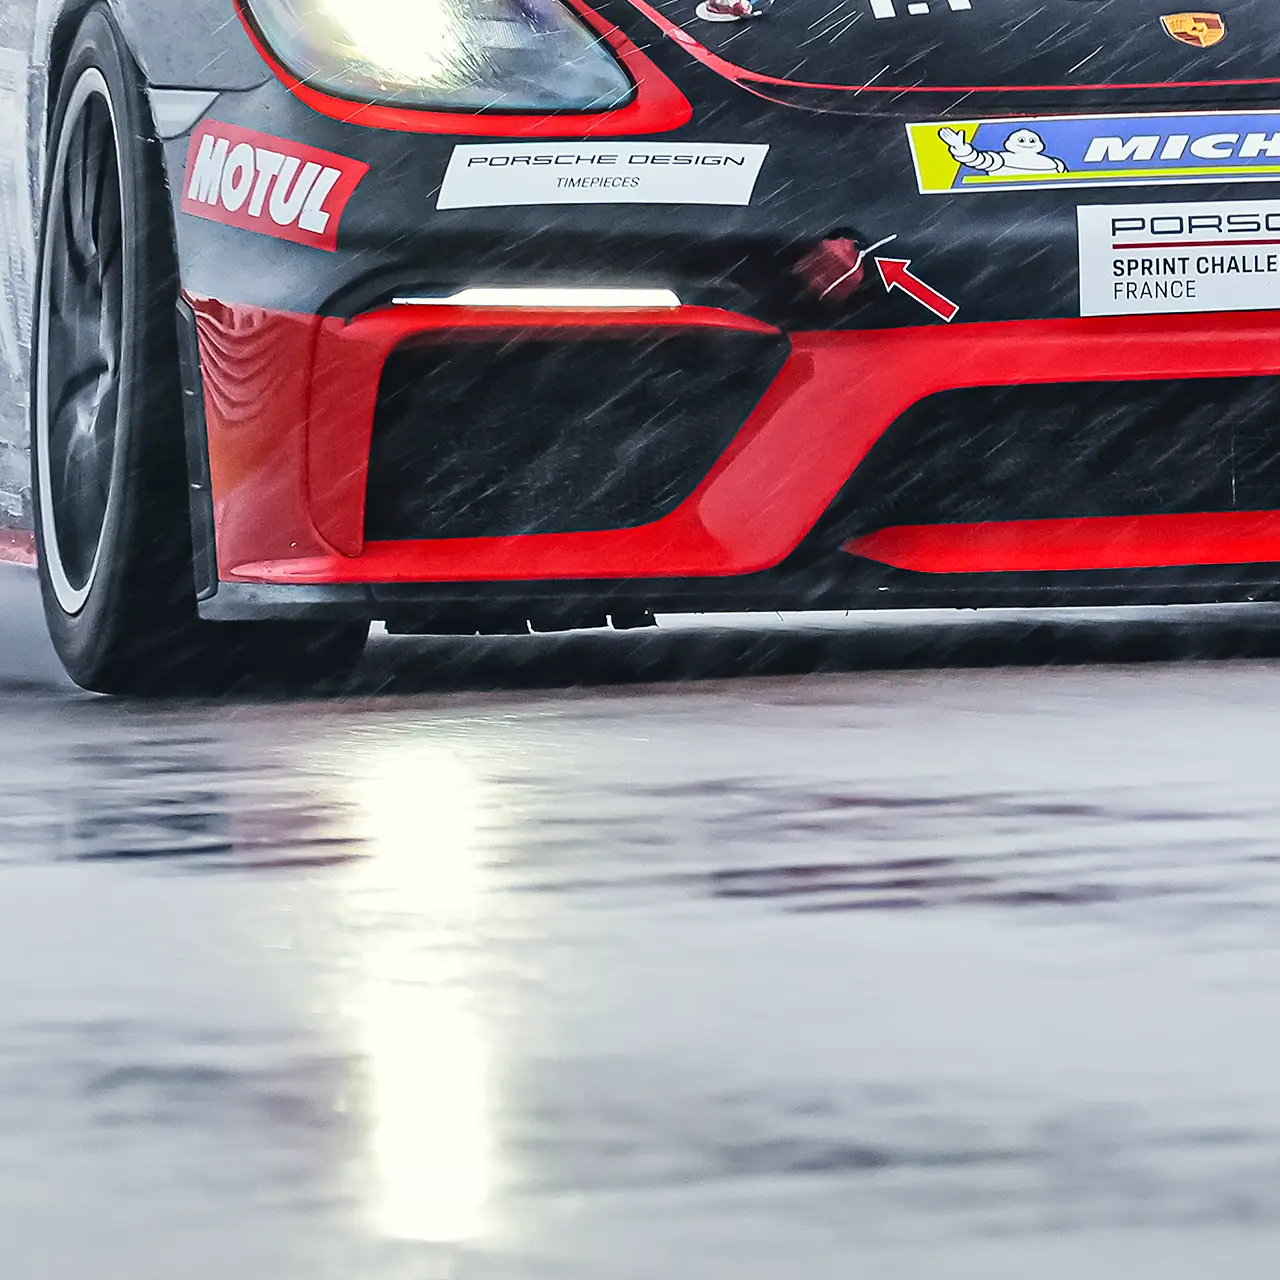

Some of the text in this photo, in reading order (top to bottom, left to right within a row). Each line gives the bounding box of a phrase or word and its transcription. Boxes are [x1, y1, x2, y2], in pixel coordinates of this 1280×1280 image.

[467, 154, 745, 168] PORSCHE DESIGN
[187, 134, 343, 234] MOTUL
[556, 175, 640, 189] TIMEPIECES
[1112, 257, 1190, 277] SPRINT
[1113, 279, 1196, 300] FRANCE
